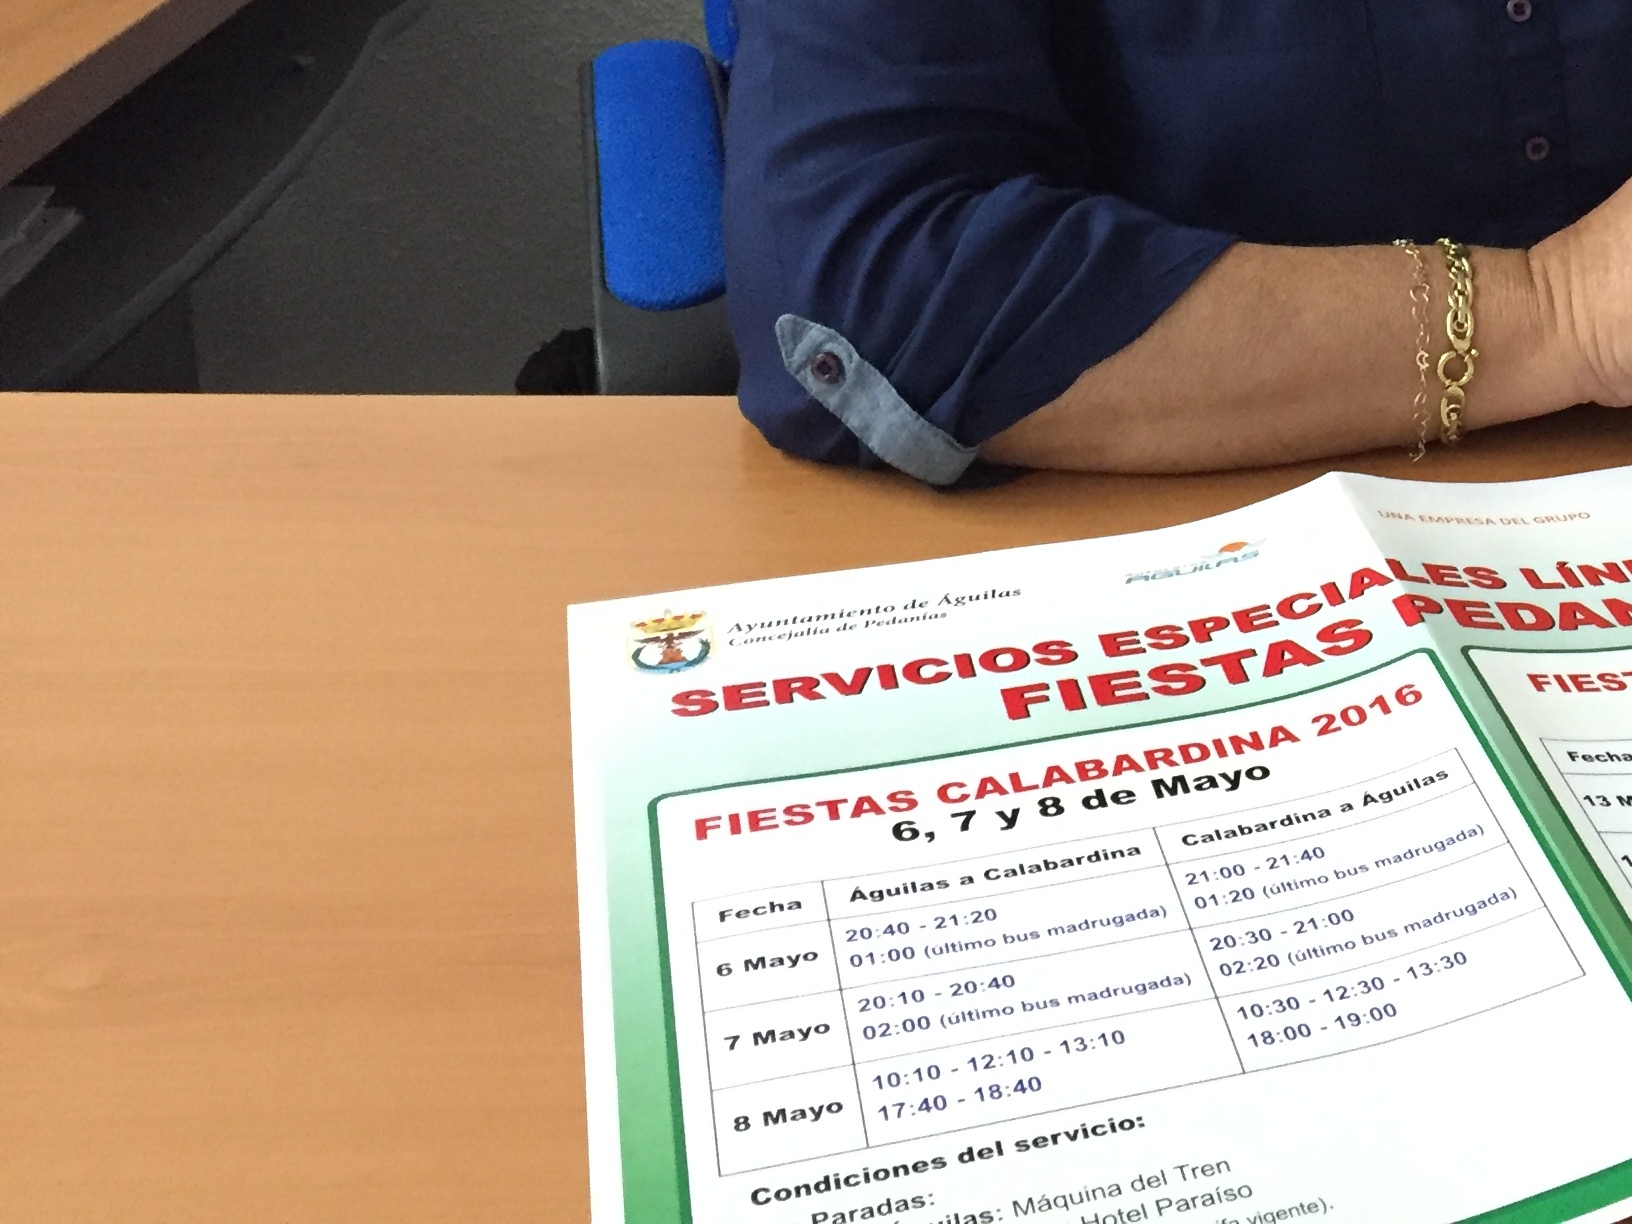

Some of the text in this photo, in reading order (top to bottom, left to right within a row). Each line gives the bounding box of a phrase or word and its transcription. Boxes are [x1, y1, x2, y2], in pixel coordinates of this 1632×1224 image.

[1378, 510, 1591, 525] UNA EMPRESA DEL GRUPO
[671, 639, 1079, 719] SERVICIOS
[1099, 558, 1507, 659] ESPECIALES
[727, 587, 1022, 634] Ayuntamiento de Águilas
[1001, 618, 1373, 720] FIESTAS
[694, 684, 1424, 842] FIESTAS CALABARDINA 2016
[891, 763, 1271, 843] 6, 7 y 8 de Mayo
[1181, 768, 1449, 848] Calabardina a Águilas
[1583, 793, 1611, 808] 13
[850, 844, 1142, 903] Águilas a Calabardina
[718, 898, 802, 923] Fecha
[850, 904, 1168, 968] 01:00 (último bus madrugada)
[717, 949, 819, 977] 6 Mayo
